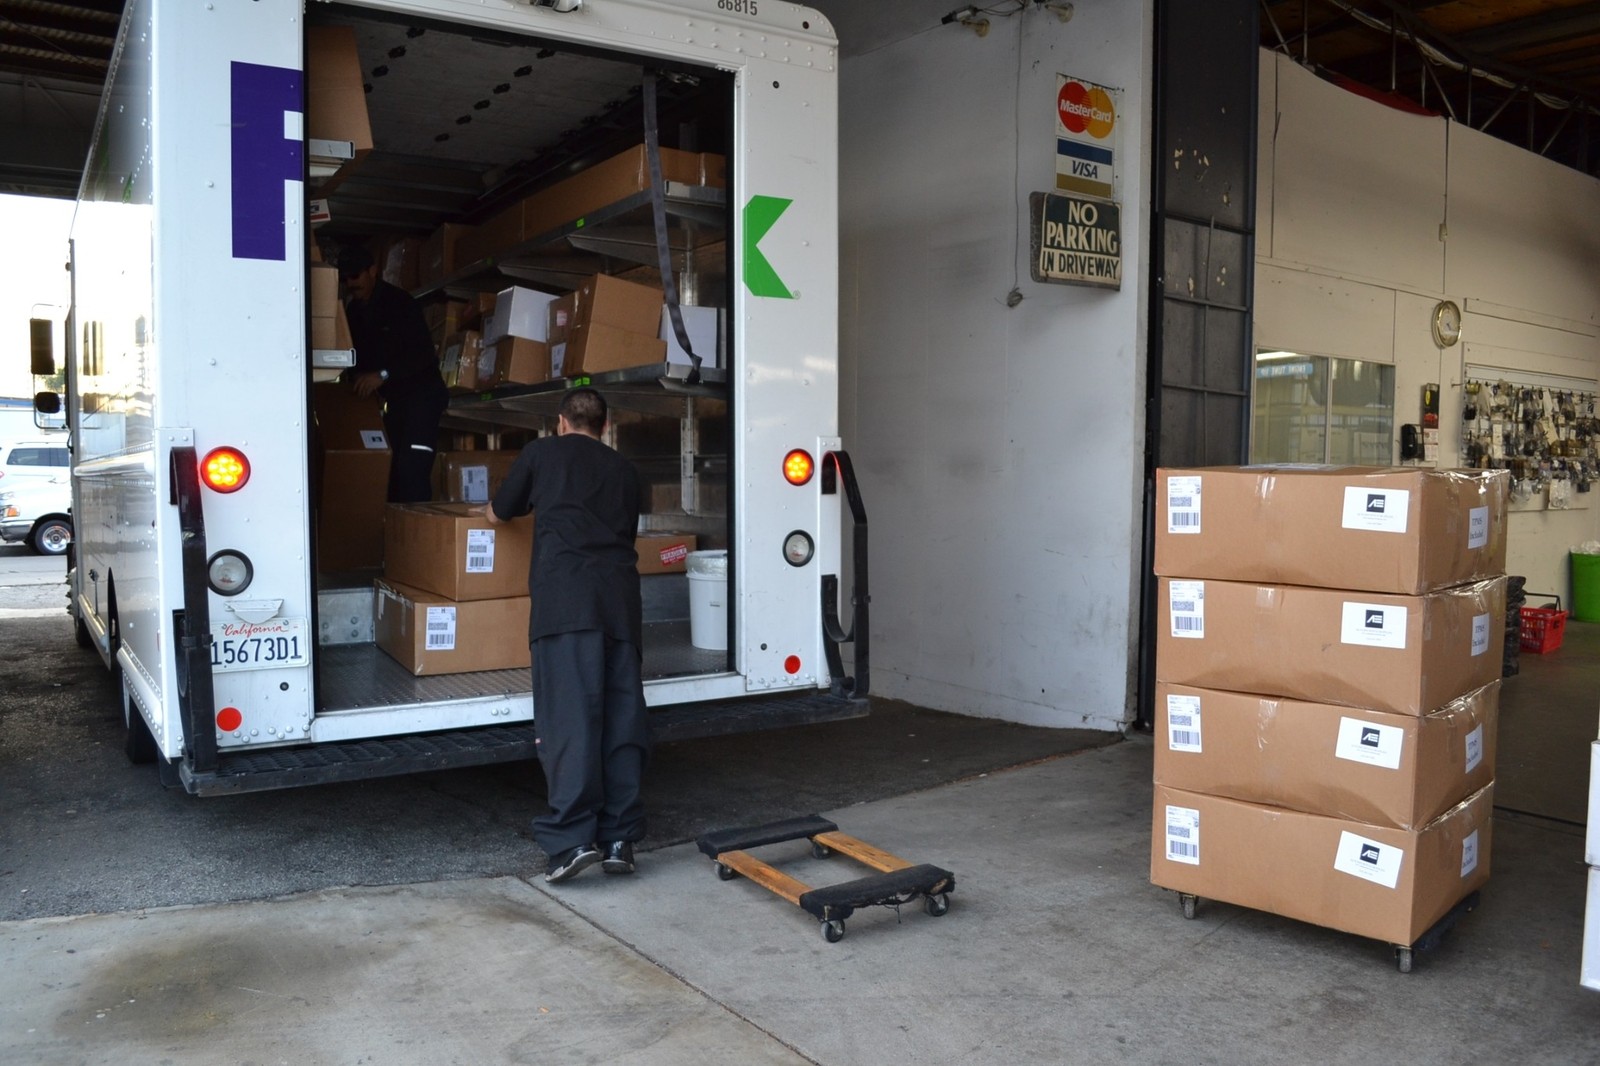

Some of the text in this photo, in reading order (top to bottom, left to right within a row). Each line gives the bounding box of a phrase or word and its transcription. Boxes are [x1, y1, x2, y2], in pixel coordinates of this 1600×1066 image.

[1060, 98, 1112, 123] MasterCard
[1072, 160, 1098, 179] VISA
[1069, 200, 1098, 226] NO
[1046, 220, 1118, 255] PARKING
[1041, 250, 1119, 280] IN DRIVEWAY
[224, 623, 288, 638] California
[210, 635, 302, 666] 15673D1
